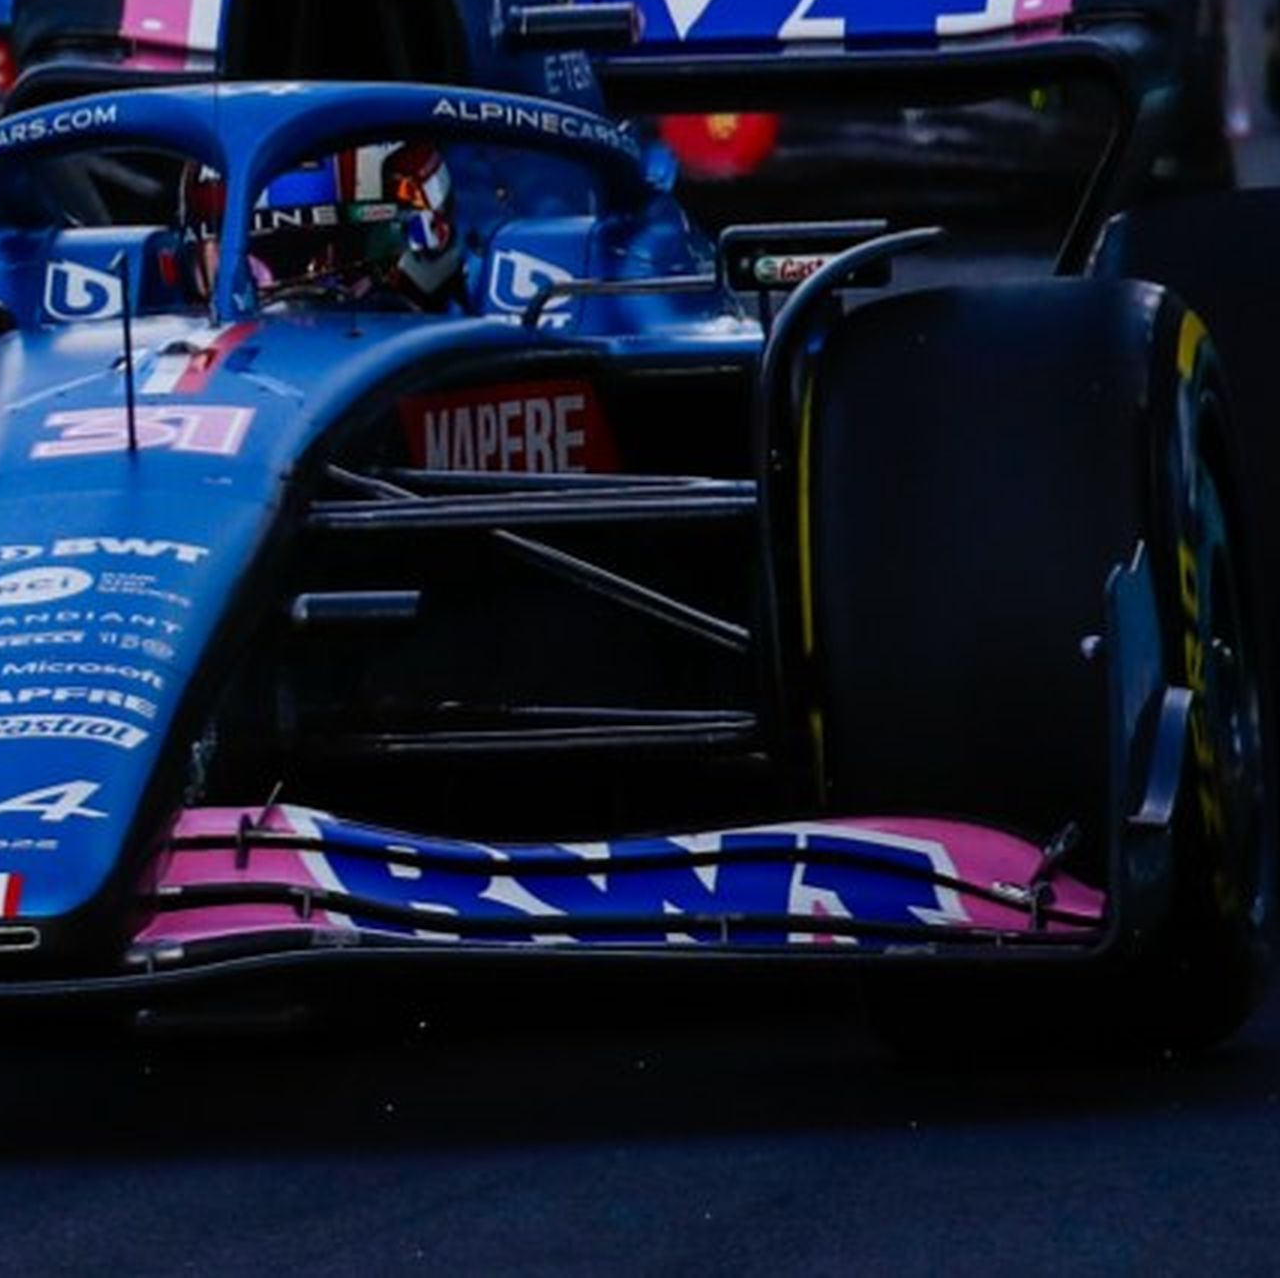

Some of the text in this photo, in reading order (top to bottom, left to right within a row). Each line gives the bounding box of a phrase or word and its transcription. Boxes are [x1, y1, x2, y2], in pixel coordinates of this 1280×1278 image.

[29, 406, 255, 459] 31
[52, 537, 210, 563] BWT
[3, 661, 164, 691] Microsoft
